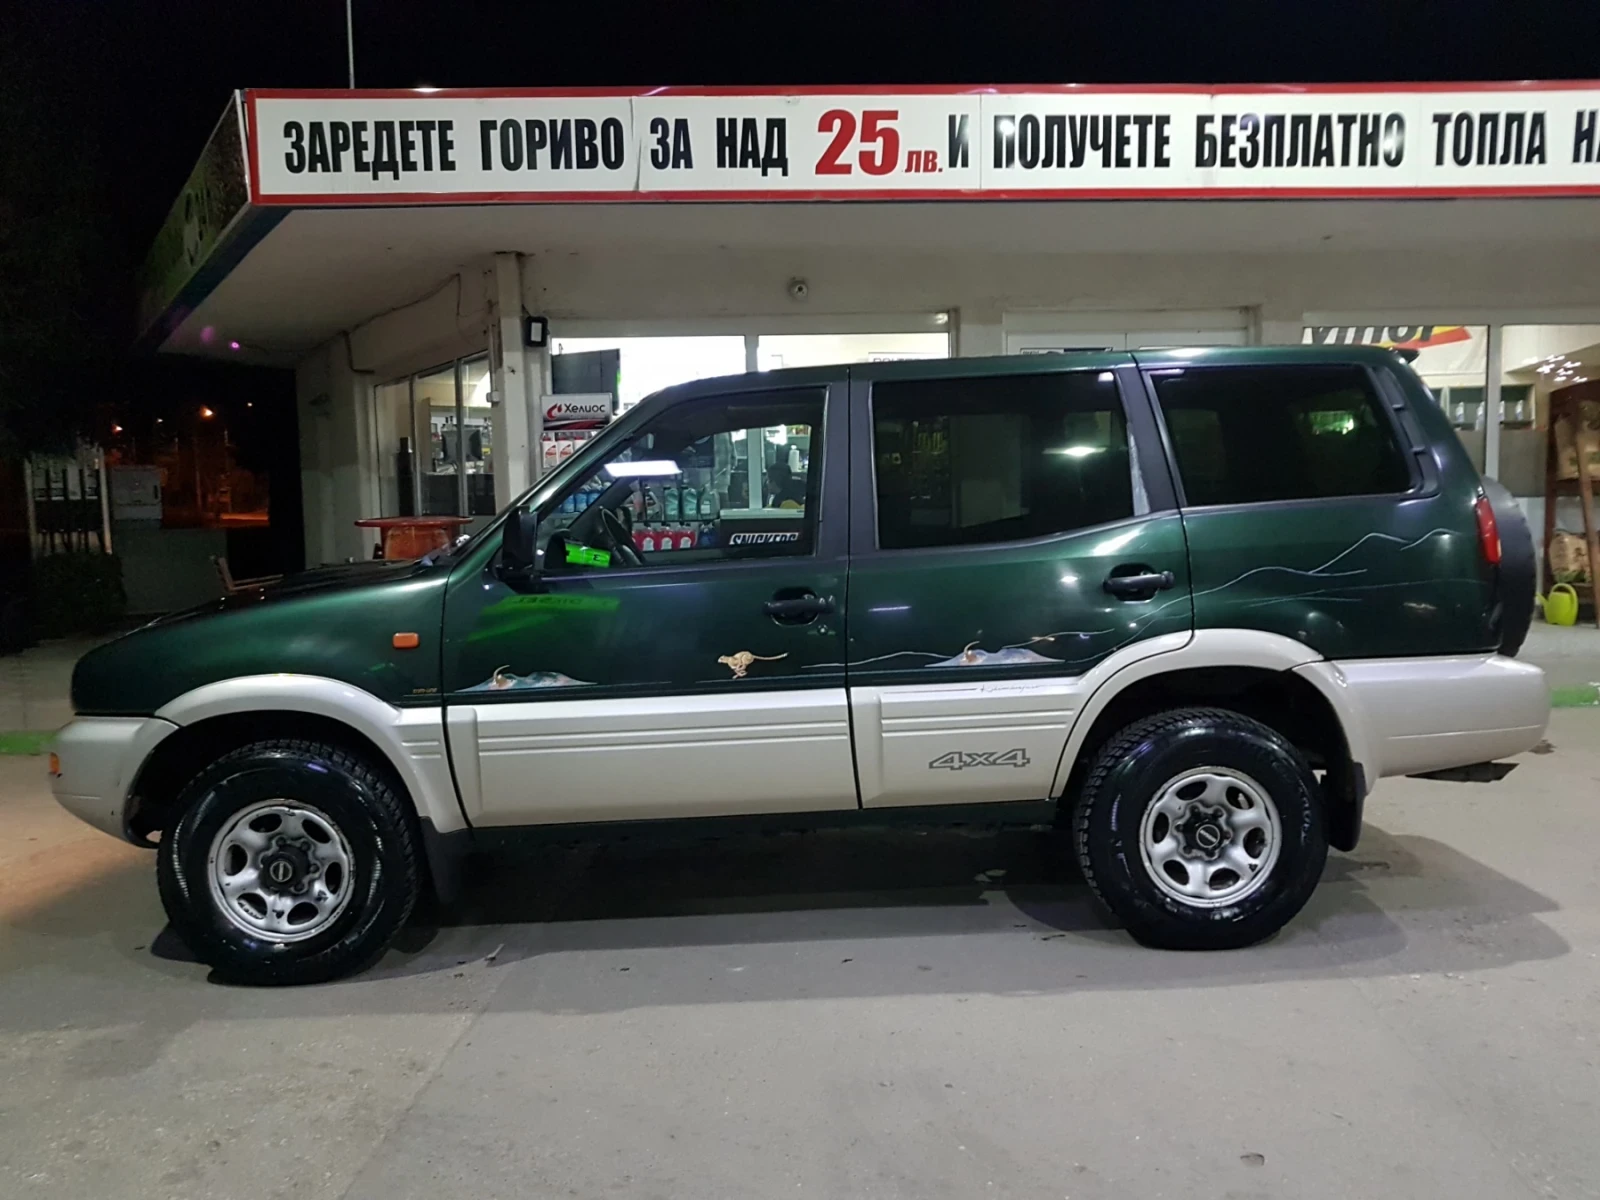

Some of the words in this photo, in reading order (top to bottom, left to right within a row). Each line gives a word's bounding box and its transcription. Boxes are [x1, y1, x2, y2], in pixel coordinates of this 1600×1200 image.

[283, 119, 457, 181] ЗАРЕДЕТЕ
[479, 117, 625, 172] ГОРИВО
[649, 117, 694, 170] ЗА
[716, 117, 789, 177] НАД
[815, 109, 900, 176] 25
[948, 114, 970, 169] И
[993, 113, 1171, 170] ПОЛУЧЕТЕ
[1195, 112, 1405, 169] БЕЗПЛАТНО
[1432, 111, 1547, 167] ТОПЛА
[1571, 108, 1600, 164] Н
[564, 403, 606, 414] Хелиос
[929, 748, 1030, 770] 4x4
